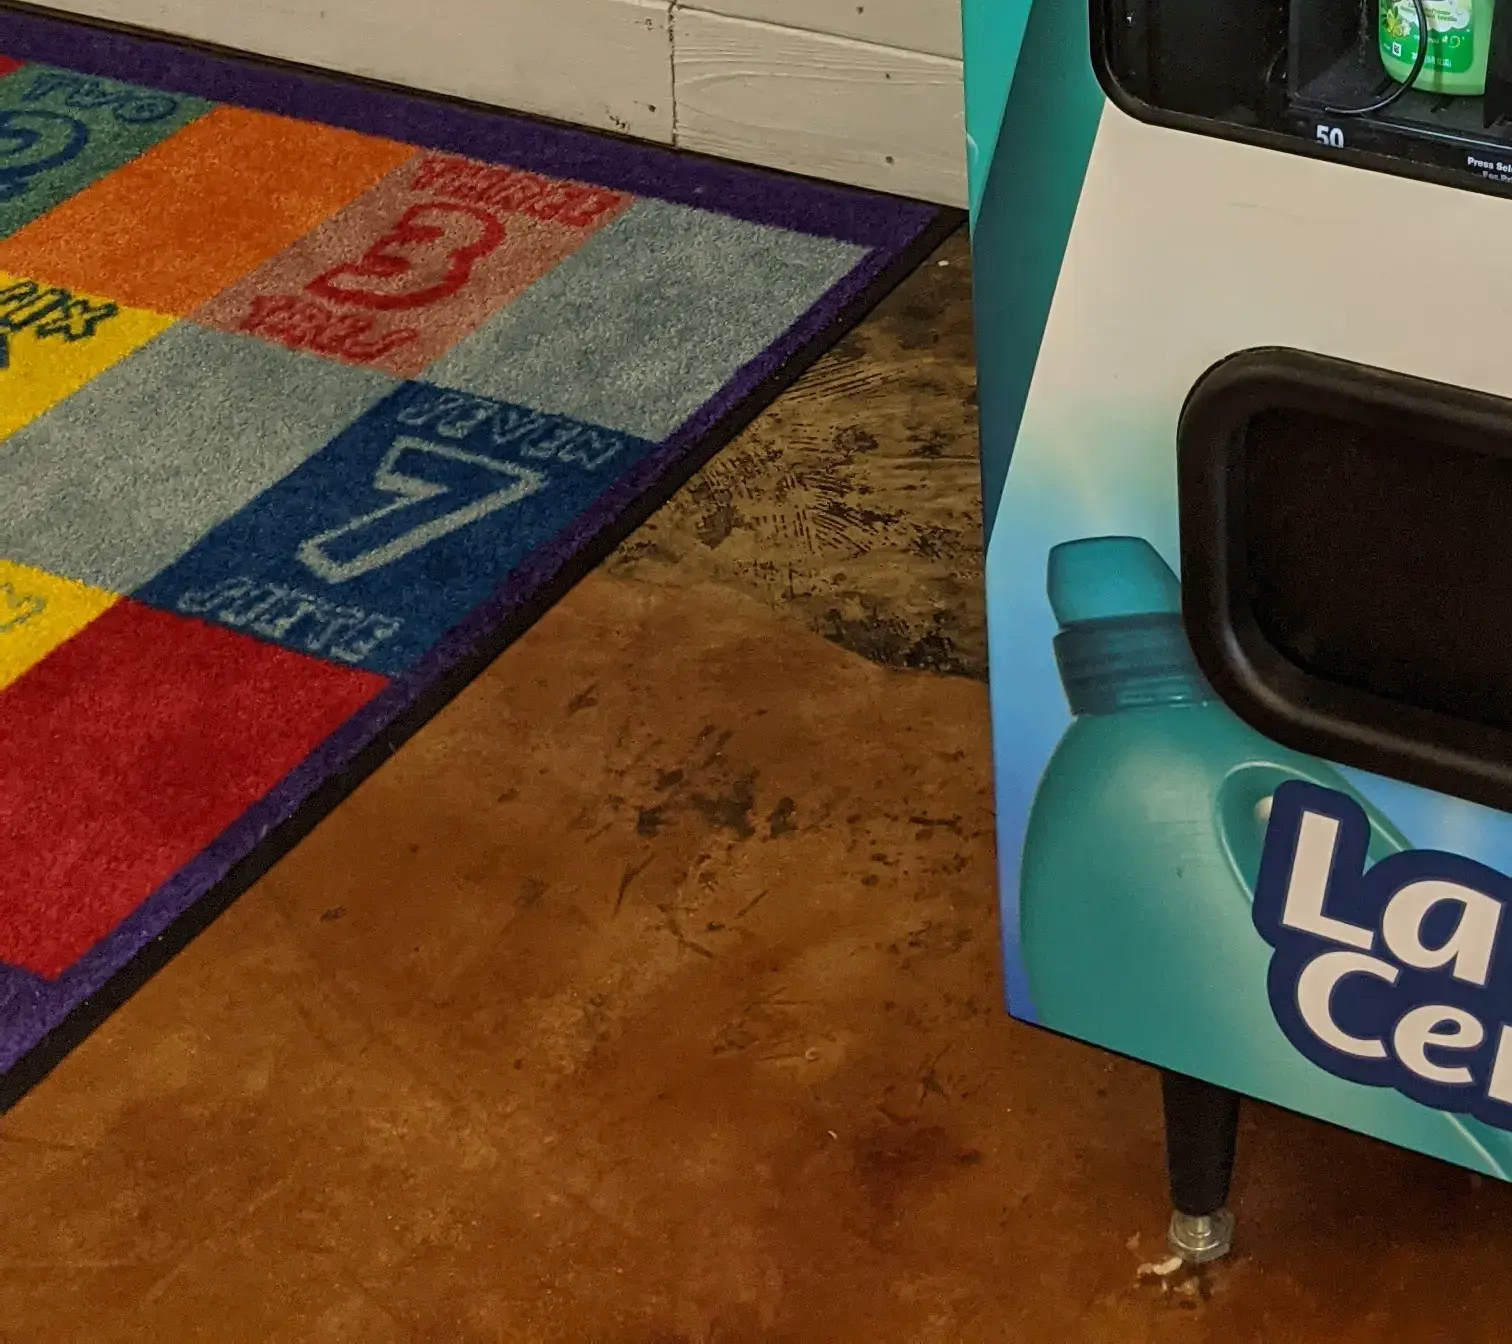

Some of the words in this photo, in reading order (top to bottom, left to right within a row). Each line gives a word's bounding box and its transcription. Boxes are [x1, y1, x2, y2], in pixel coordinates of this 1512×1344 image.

[1316, 125, 1345, 149] 50
[304, 202, 502, 312] 3
[296, 434, 550, 586] 7
